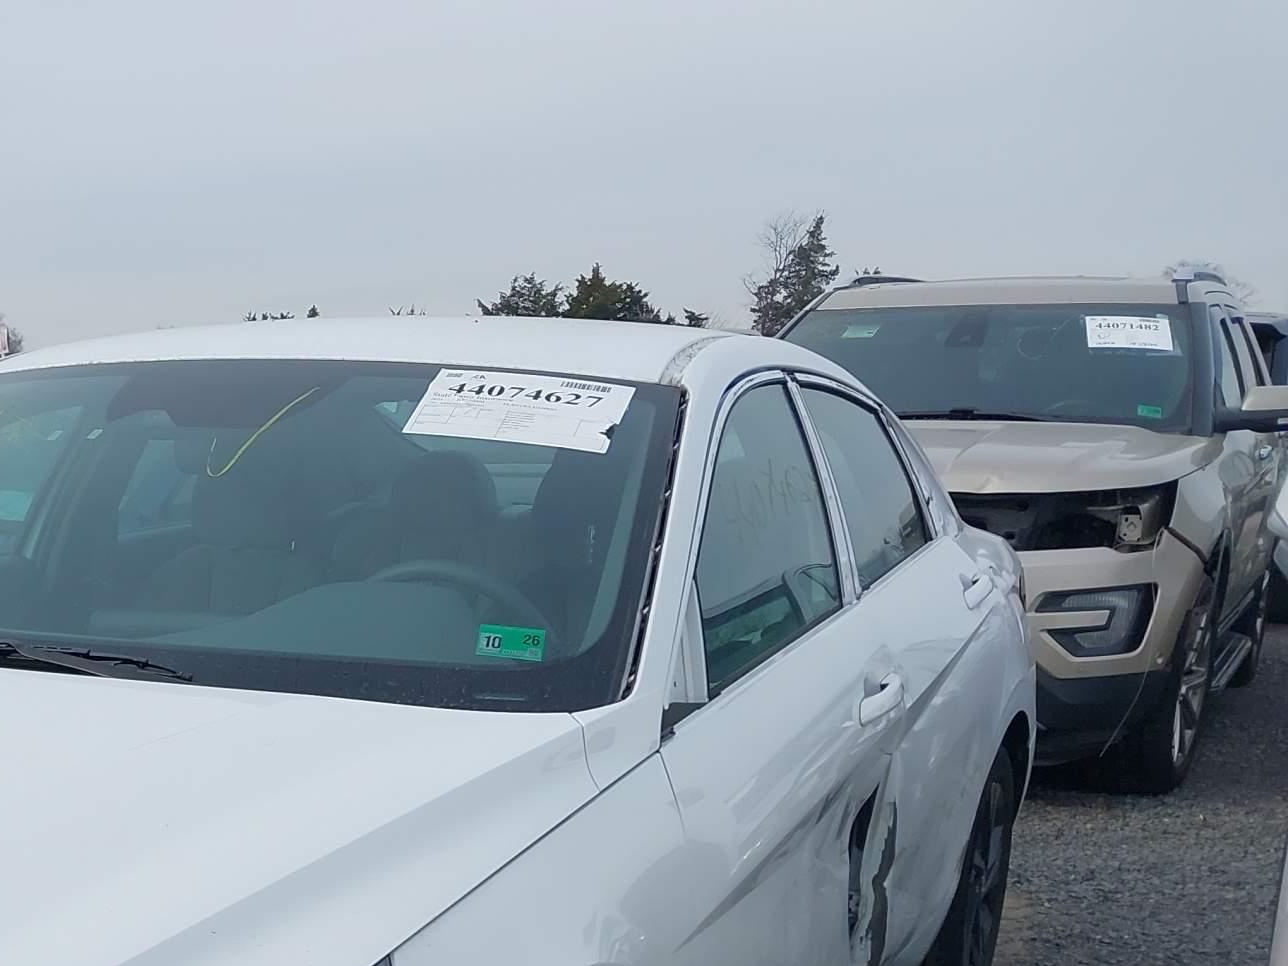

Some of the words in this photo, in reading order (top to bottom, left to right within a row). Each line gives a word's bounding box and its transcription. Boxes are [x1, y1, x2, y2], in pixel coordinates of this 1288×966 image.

[448, 382, 604, 408] 44074627
[484, 635, 503, 649] 10
[523, 634, 541, 647] 26
